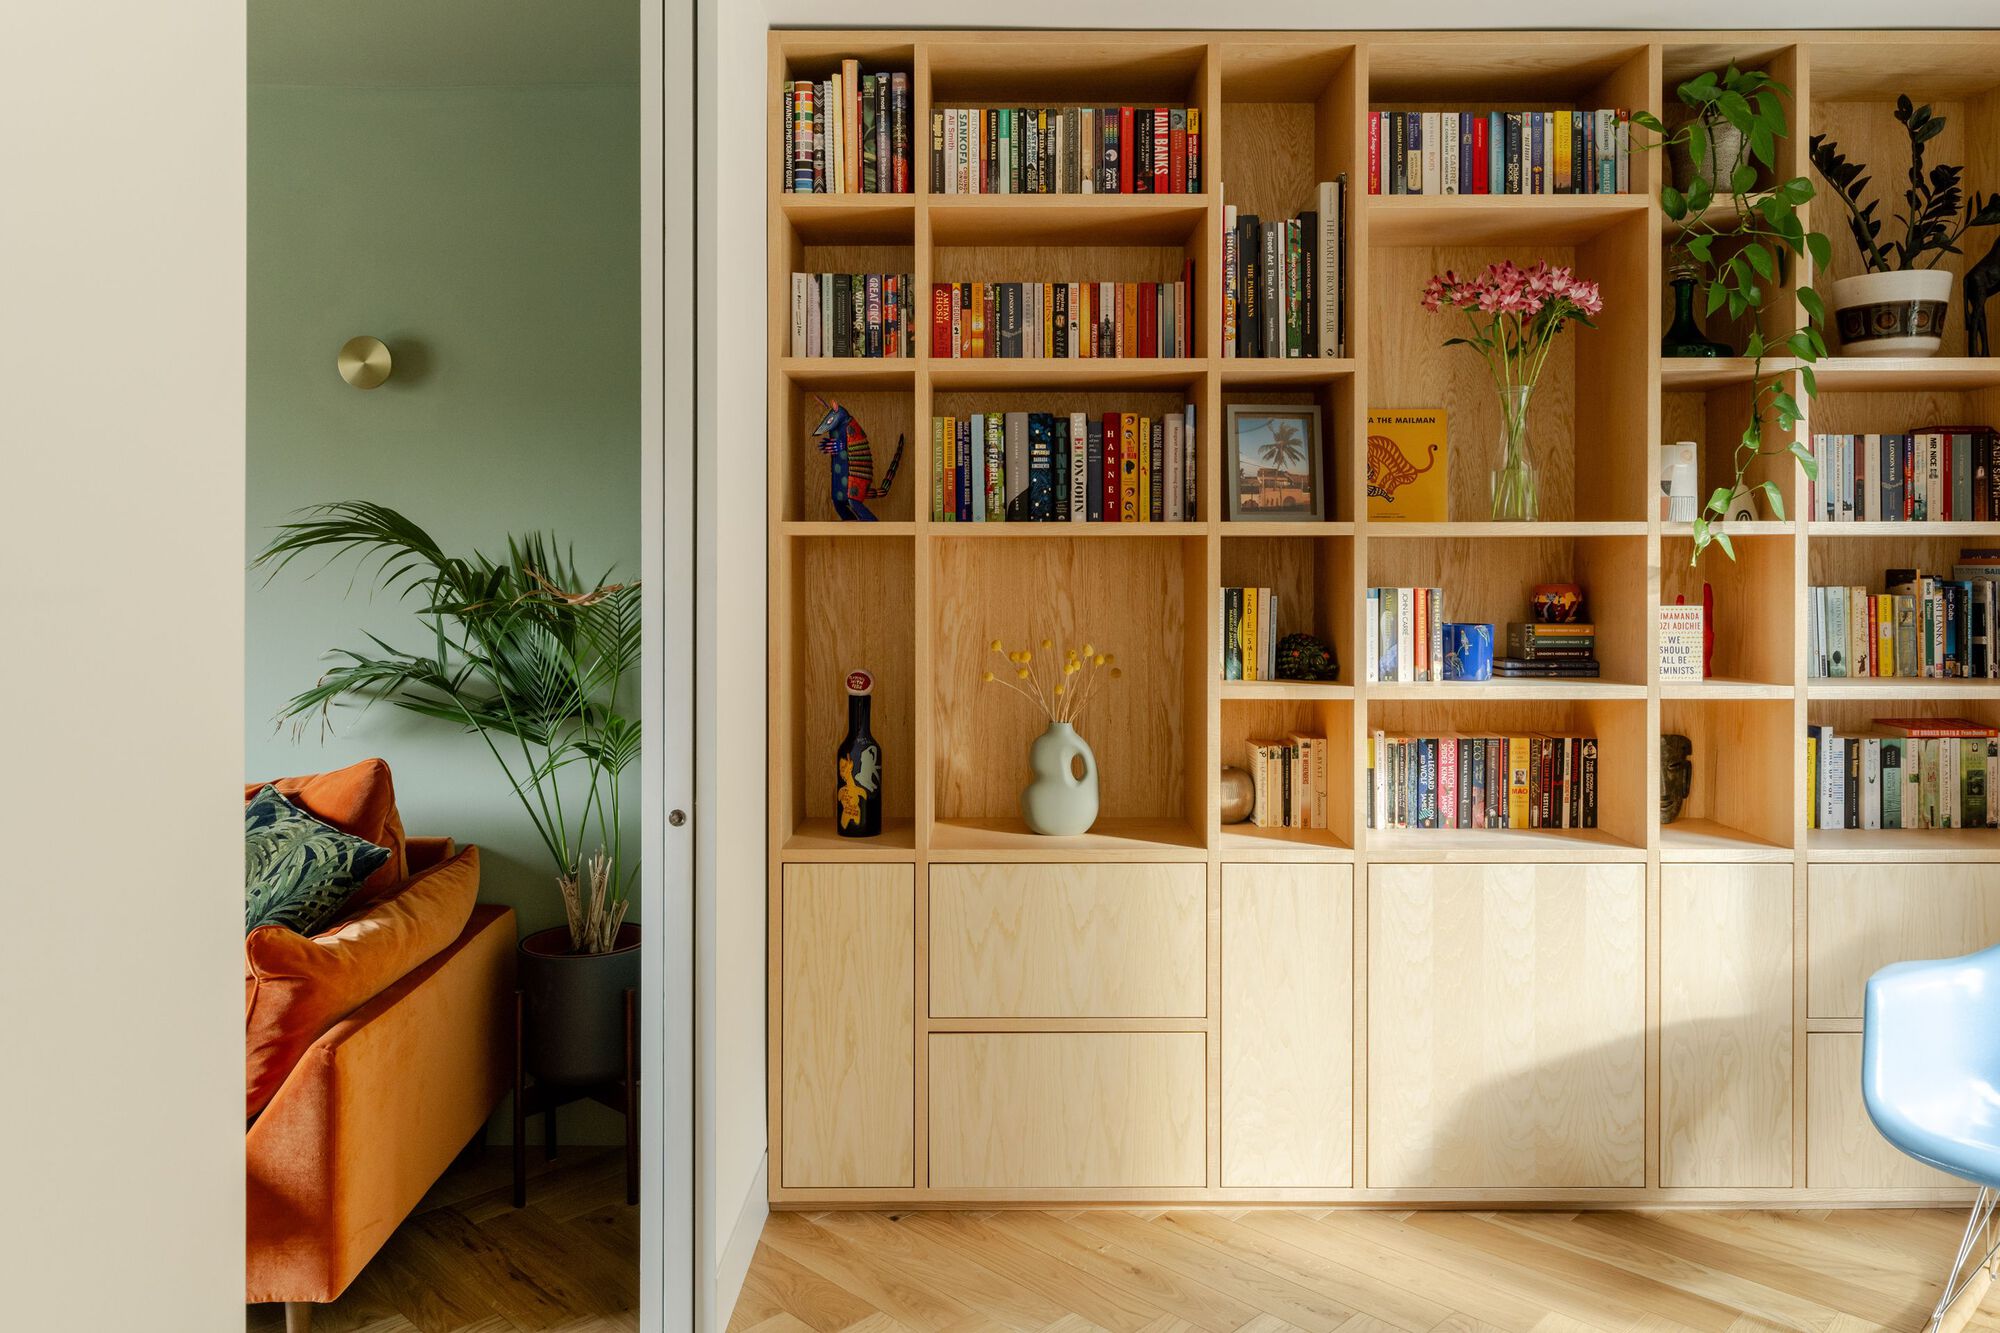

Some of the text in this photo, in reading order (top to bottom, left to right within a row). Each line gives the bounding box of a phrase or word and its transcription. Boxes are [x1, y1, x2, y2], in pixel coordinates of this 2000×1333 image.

[959, 114, 967, 165] SANKOFA
[1154, 111, 1168, 175] IAIN BANKS
[1450, 145, 1456, 153] le
[1225, 228, 1235, 262] WORL
[1326, 218, 1334, 333] THE EARTH FROM THE AIR
[855, 291, 863, 330] WILDING
[869, 277, 879, 330] GREAT CIRCLE
[935, 289, 943, 324] GHOSH
[988, 418, 997, 445] MAGGIE
[1930, 437, 1937, 449] MR
[1074, 438, 1084, 512] ELTON JOHN
[1107, 430, 1115, 509] HAMNET
[1668, 636, 1680, 644] WE
[1673, 622, 1700, 630] ADICHIE
[1660, 646, 1690, 654] SHOULD
[1662, 656, 1686, 664] ALL BE
[1463, 751, 1468, 759] WE
